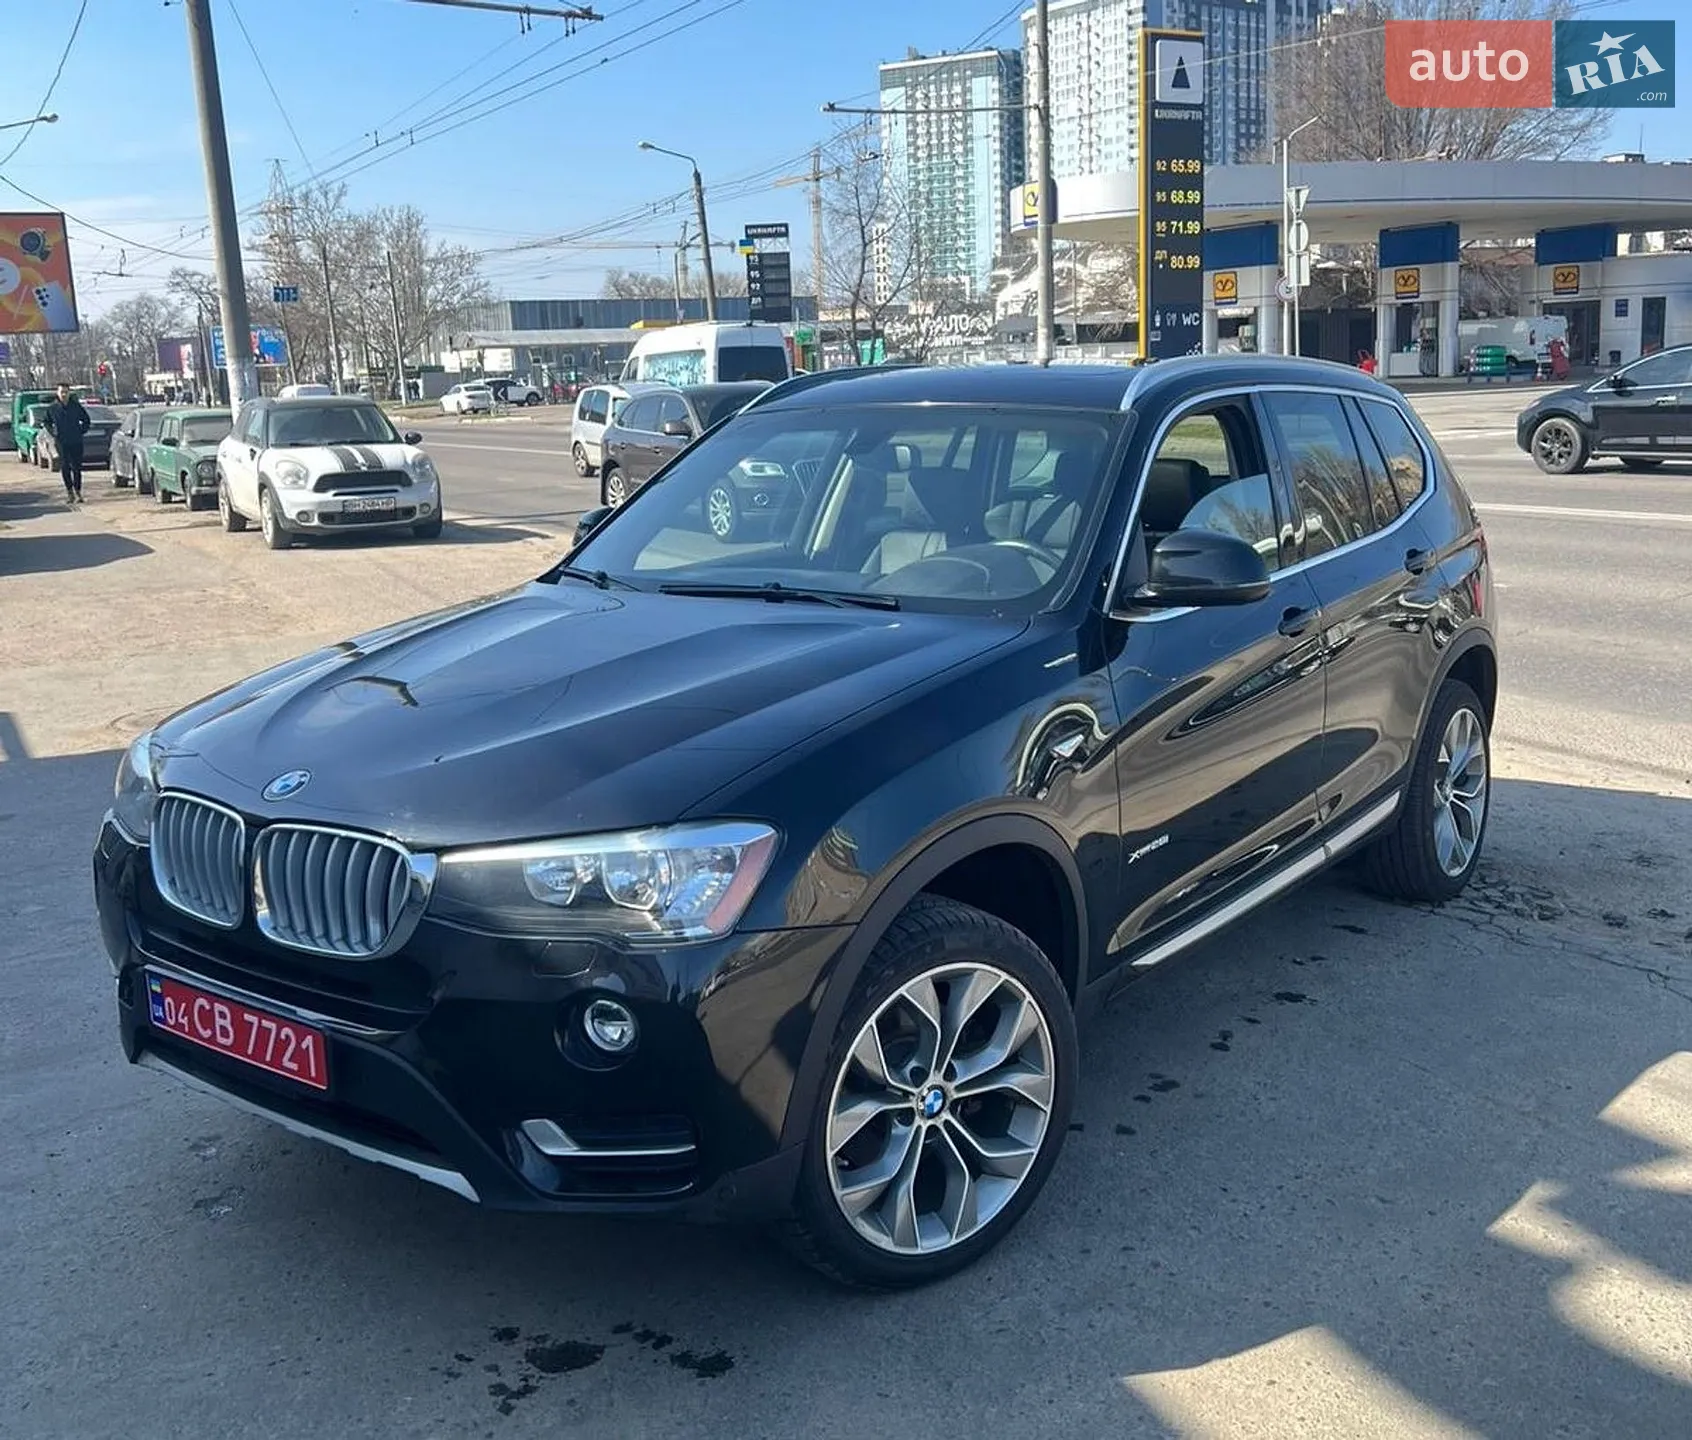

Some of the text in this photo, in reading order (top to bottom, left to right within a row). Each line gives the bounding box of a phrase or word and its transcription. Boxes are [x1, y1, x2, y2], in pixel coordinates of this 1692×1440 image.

[1155, 158, 1201, 174] 92 65.99
[1170, 189, 1201, 204] 68.99
[1170, 220, 1201, 235] 71.99
[1170, 255, 1201, 269] 80.99
[1181, 312, 1200, 326] WC
[153, 1004, 165, 1019] UA
[243, 1012, 316, 1078] 7721
